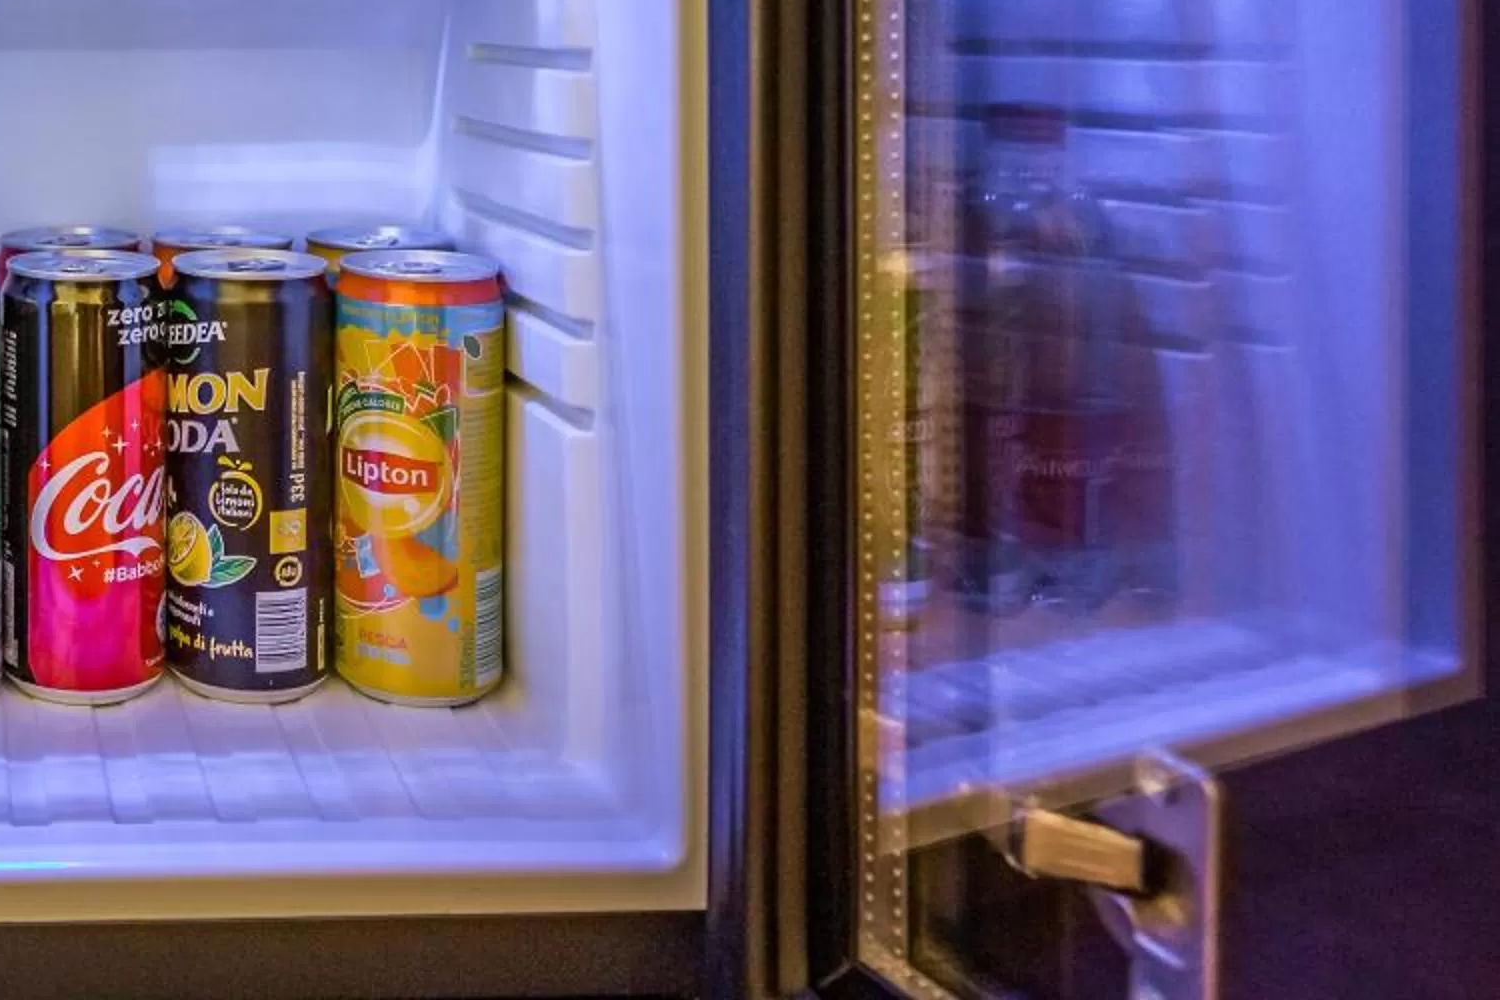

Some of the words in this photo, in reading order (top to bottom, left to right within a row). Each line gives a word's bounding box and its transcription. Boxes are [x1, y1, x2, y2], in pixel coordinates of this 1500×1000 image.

[107, 305, 153, 327] zero
[118, 323, 158, 345] zero
[346, 453, 429, 487] Lipton
[31, 451, 164, 561] Coca
[209, 635, 254, 661] frutta
